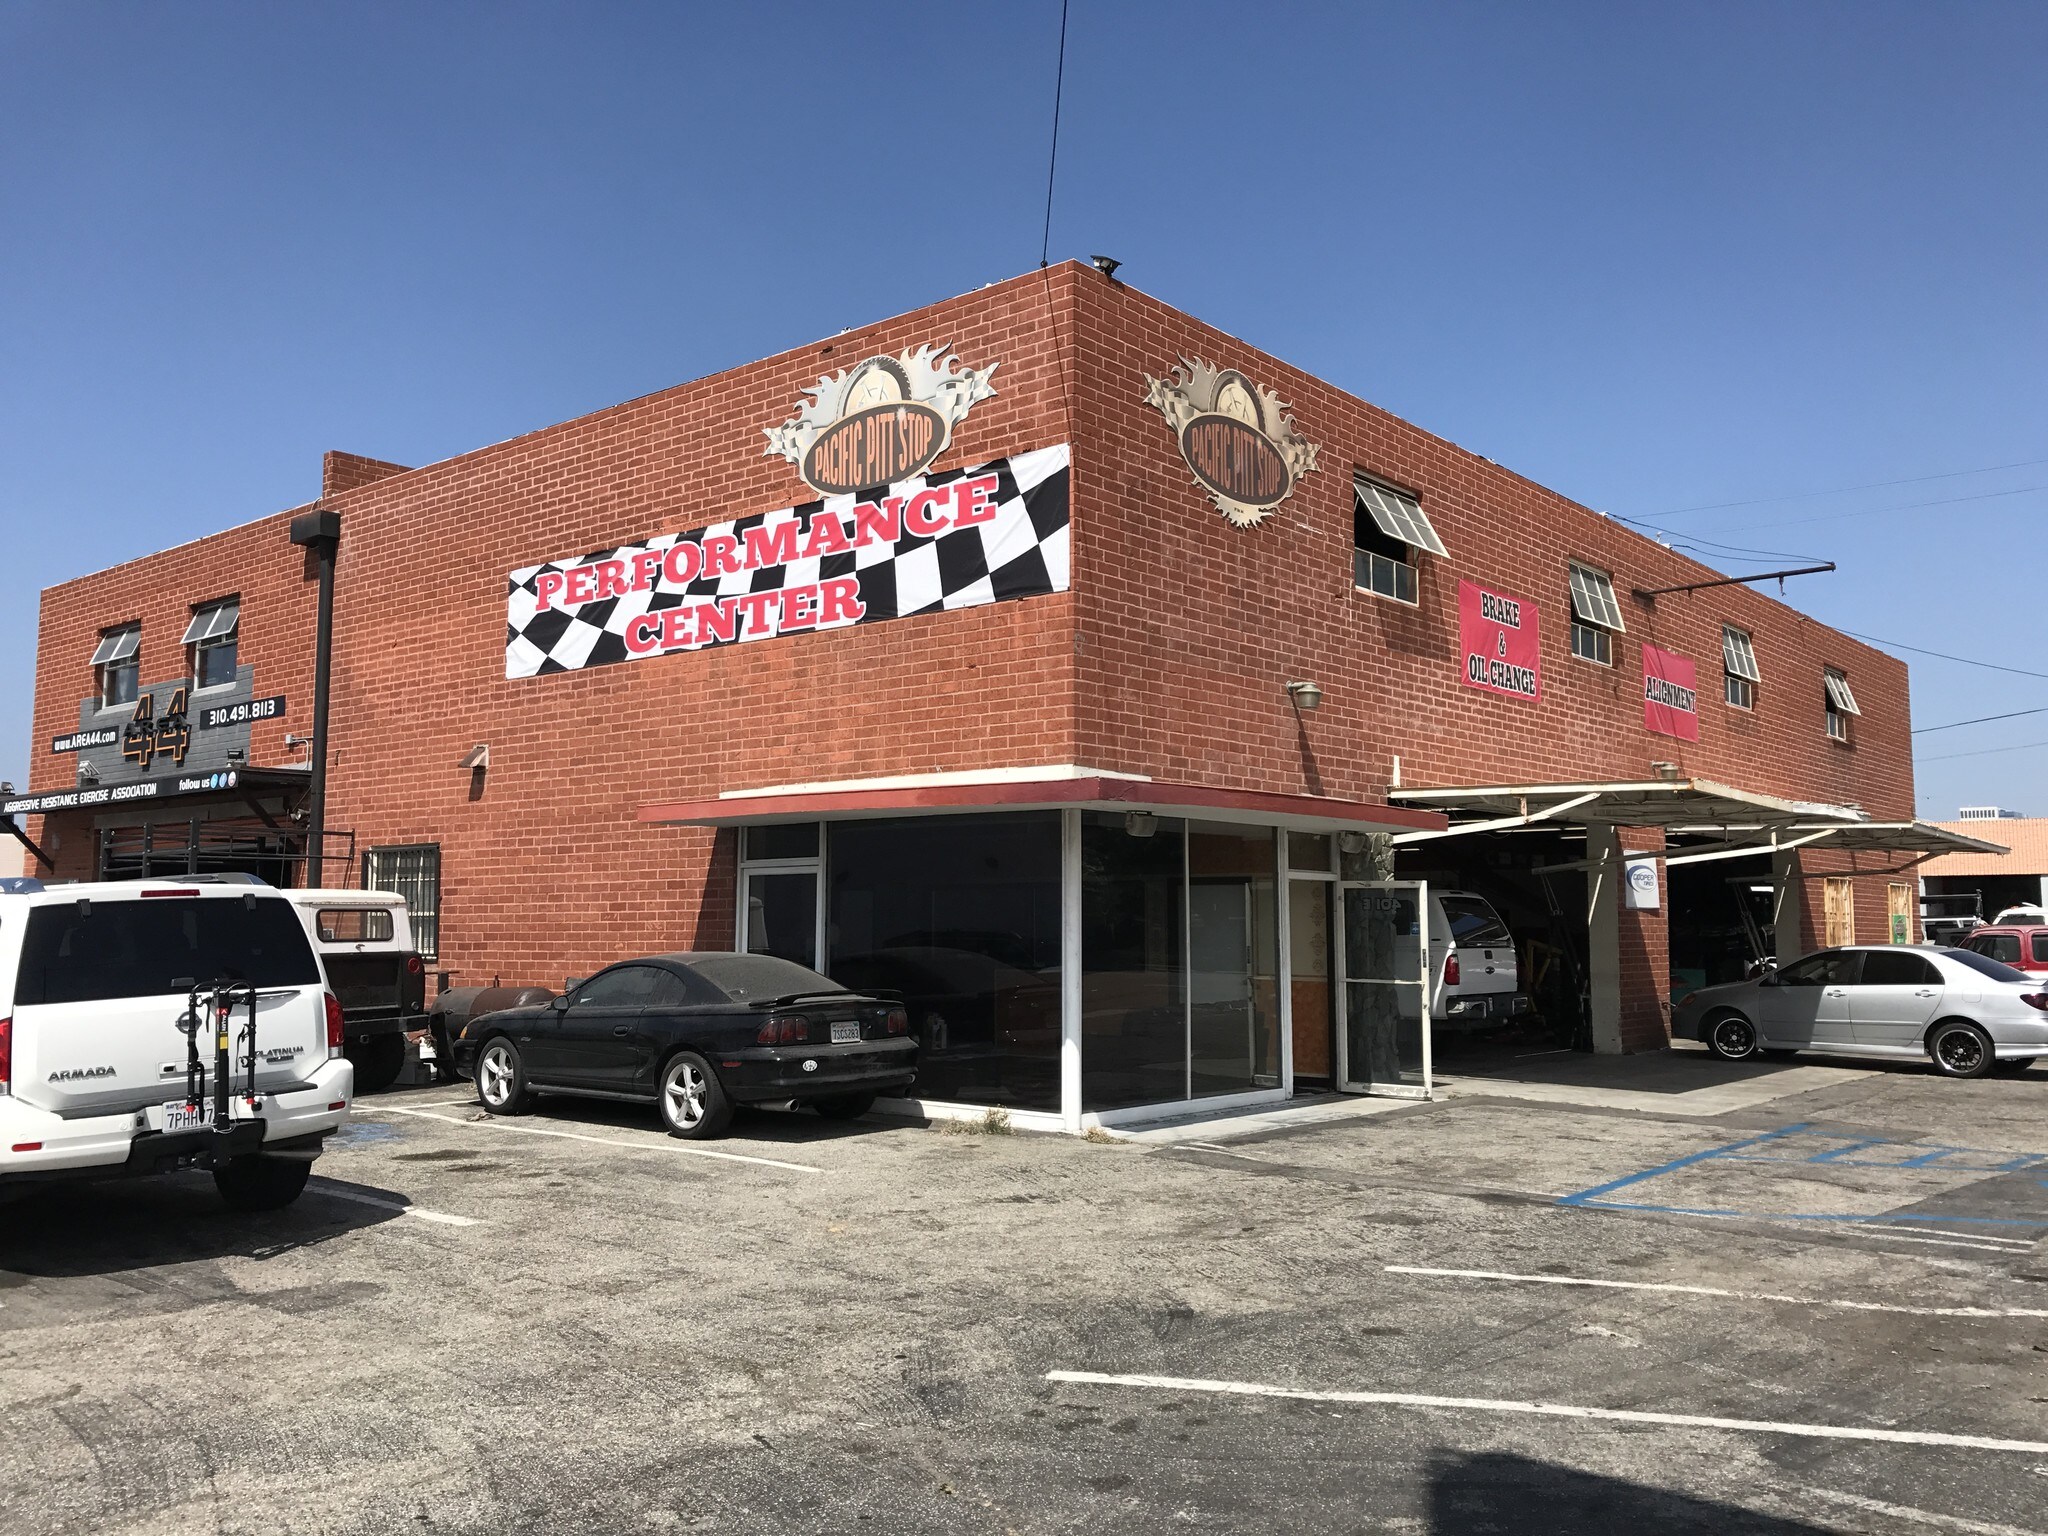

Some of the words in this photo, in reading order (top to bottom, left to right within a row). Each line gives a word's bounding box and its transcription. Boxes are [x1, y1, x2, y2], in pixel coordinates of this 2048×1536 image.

[814, 420, 862, 486] PACIFIC
[866, 412, 897, 484] PITT
[898, 411, 933, 471] STOP
[1191, 423, 1231, 490] PACIFIC
[1233, 426, 1255, 497] PITT
[1257, 439, 1280, 497] STOP
[534, 474, 999, 612] PERFORMANCE
[624, 578, 867, 654] CENTER
[1481, 592, 1520, 628] BRAKE
[1499, 632, 1506, 655] &
[1468, 654, 1488, 683] OIL
[1490, 660, 1536, 695] CHANGE
[1645, 676, 1696, 713] ALIGNMENT
[121, 687, 188, 766] 44
[123, 714, 188, 738] AREA
[208, 699, 276, 727] 310.491.8113
[54, 730, 117, 751] www.AREA44.com
[3, 798, 40, 813] AGGRESSIVE
[40, 793, 78, 809] RESISTANCE
[79, 789, 109, 804] EXERCISE
[110, 782, 157, 800] ASSOCIATION
[179, 778, 200, 790] follow
[201, 778, 210, 788] us
[1632, 873, 1654, 881] COOPER
[255, 1046, 304, 1058] PLATINUM
[48, 1065, 117, 1082] ARMADA
[166, 1108, 214, 1130] 7PHH7
